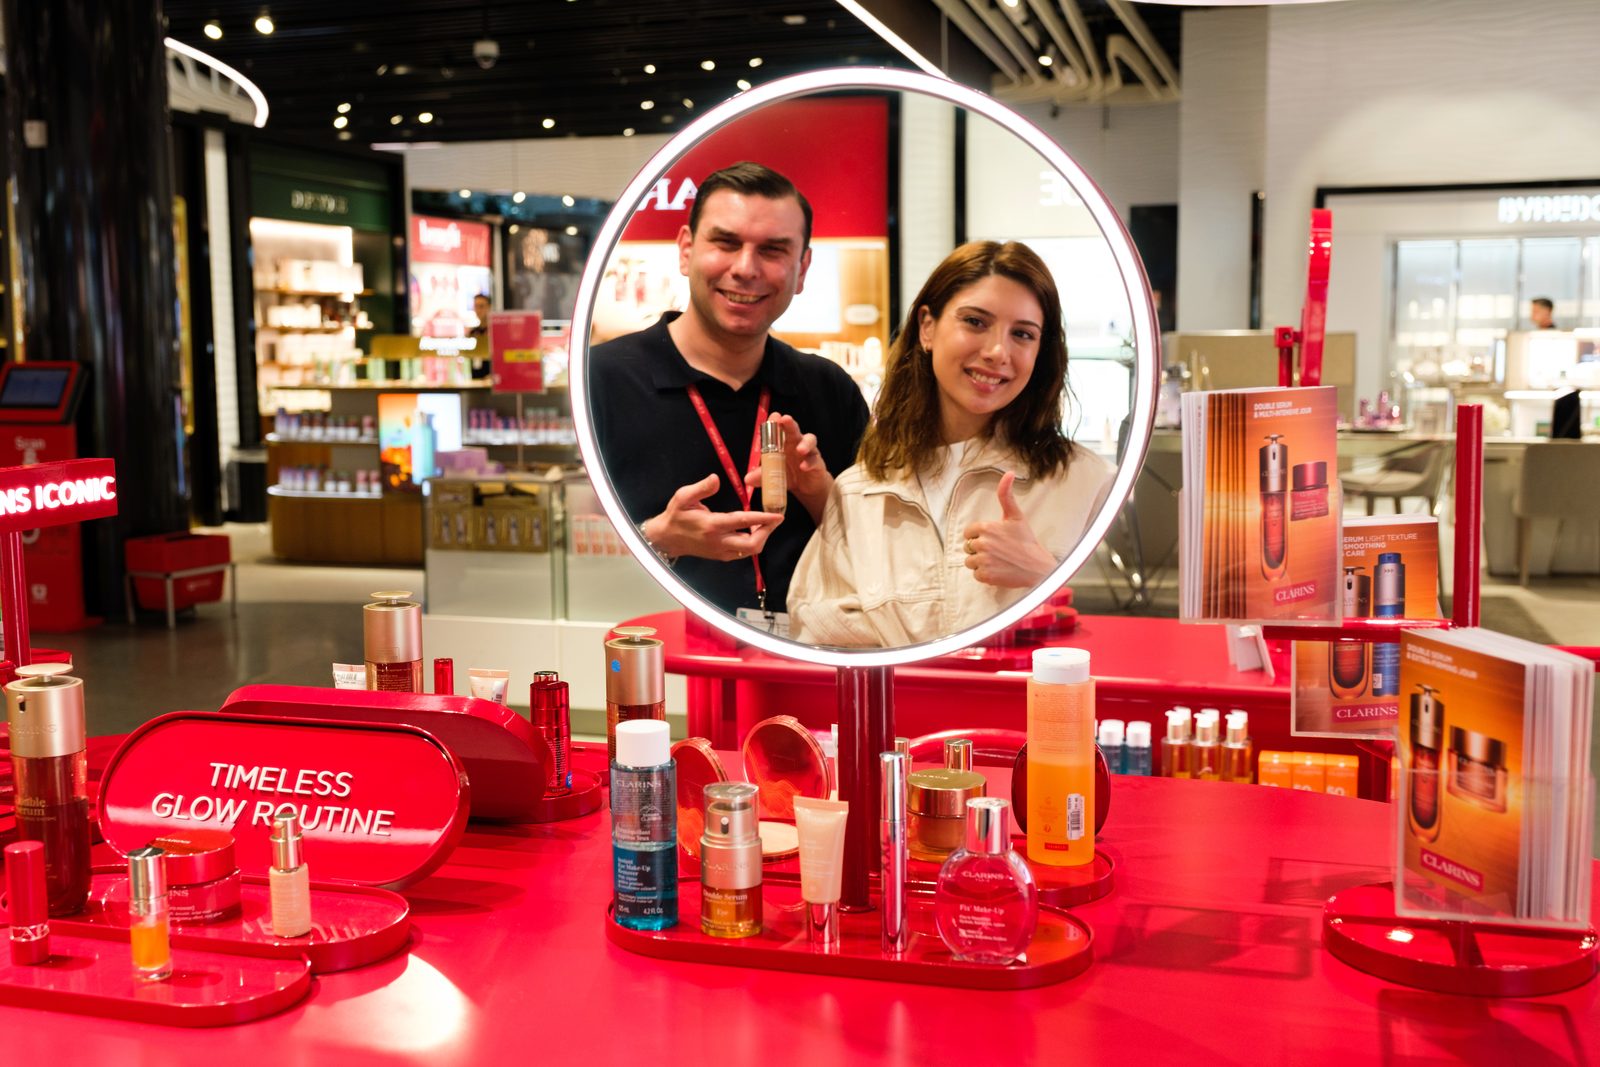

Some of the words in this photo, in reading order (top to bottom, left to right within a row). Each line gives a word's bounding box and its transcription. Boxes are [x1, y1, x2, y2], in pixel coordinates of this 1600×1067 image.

[35, 476, 116, 510] ICONIC
[1343, 535, 1364, 543] ERUM
[1364, 534, 1385, 542] LIGHT
[1387, 532, 1418, 541] TEXTURE
[1343, 541, 1386, 550] SMOOTHING
[1345, 549, 1365, 557] CARE
[1276, 584, 1315, 602] CLARINS
[1336, 706, 1398, 719] CLARINS
[210, 762, 353, 798] TIMELESS
[616, 780, 662, 788] CLARINS
[151, 792, 247, 824] GLOW
[252, 800, 396, 837] ROUTINE
[961, 870, 1004, 880] CLARINS
[1423, 852, 1480, 887] CLARINS
[973, 905, 1005, 915] Make-Up
